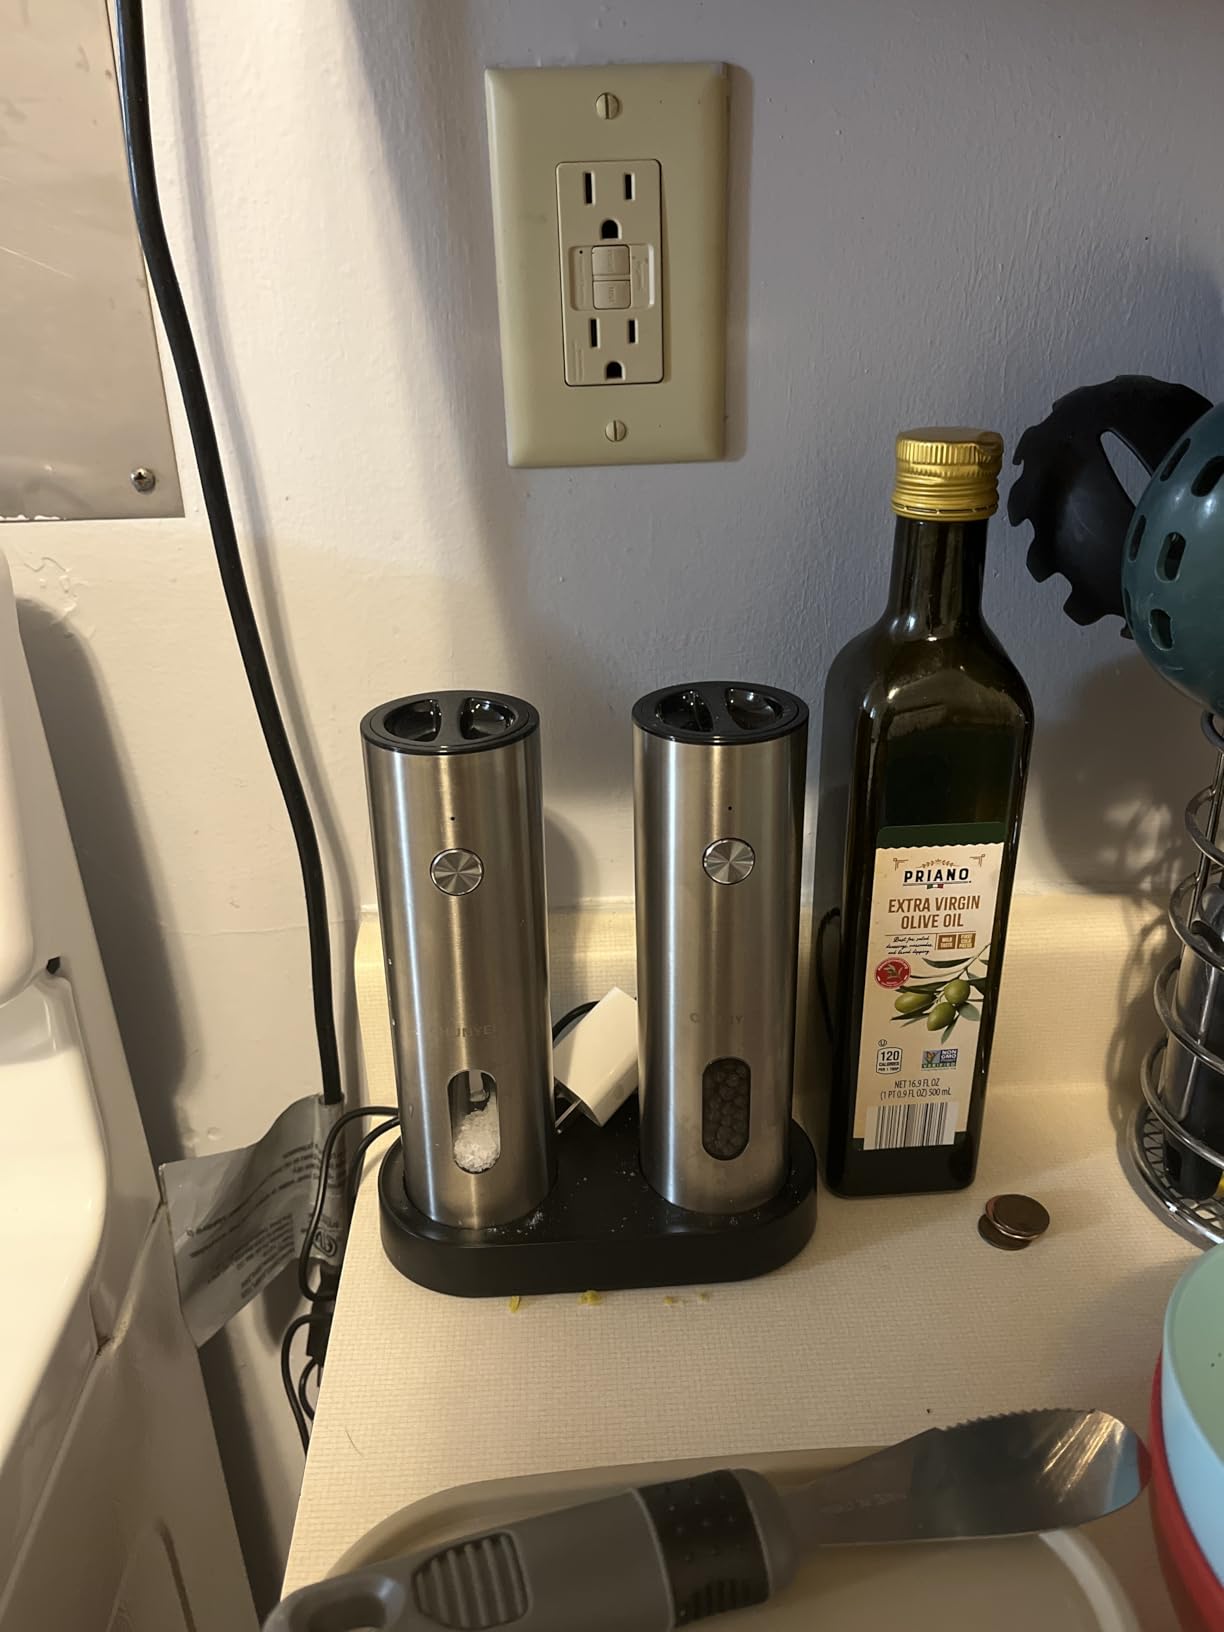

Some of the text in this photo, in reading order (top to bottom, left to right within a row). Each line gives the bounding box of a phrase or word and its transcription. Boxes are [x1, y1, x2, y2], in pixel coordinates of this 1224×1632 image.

[904, 868, 969, 882] PRIANO
[888, 895, 981, 914] EXTRA VIRGIN
[901, 913, 964, 930] OLIVE OIL
[881, 1051, 900, 1061] 120
[895, 1078, 941, 1089] NET 16.9 FL OZ
[880, 1087, 952, 1101] (1 PT 0.9 FL OZ) 500 mL
